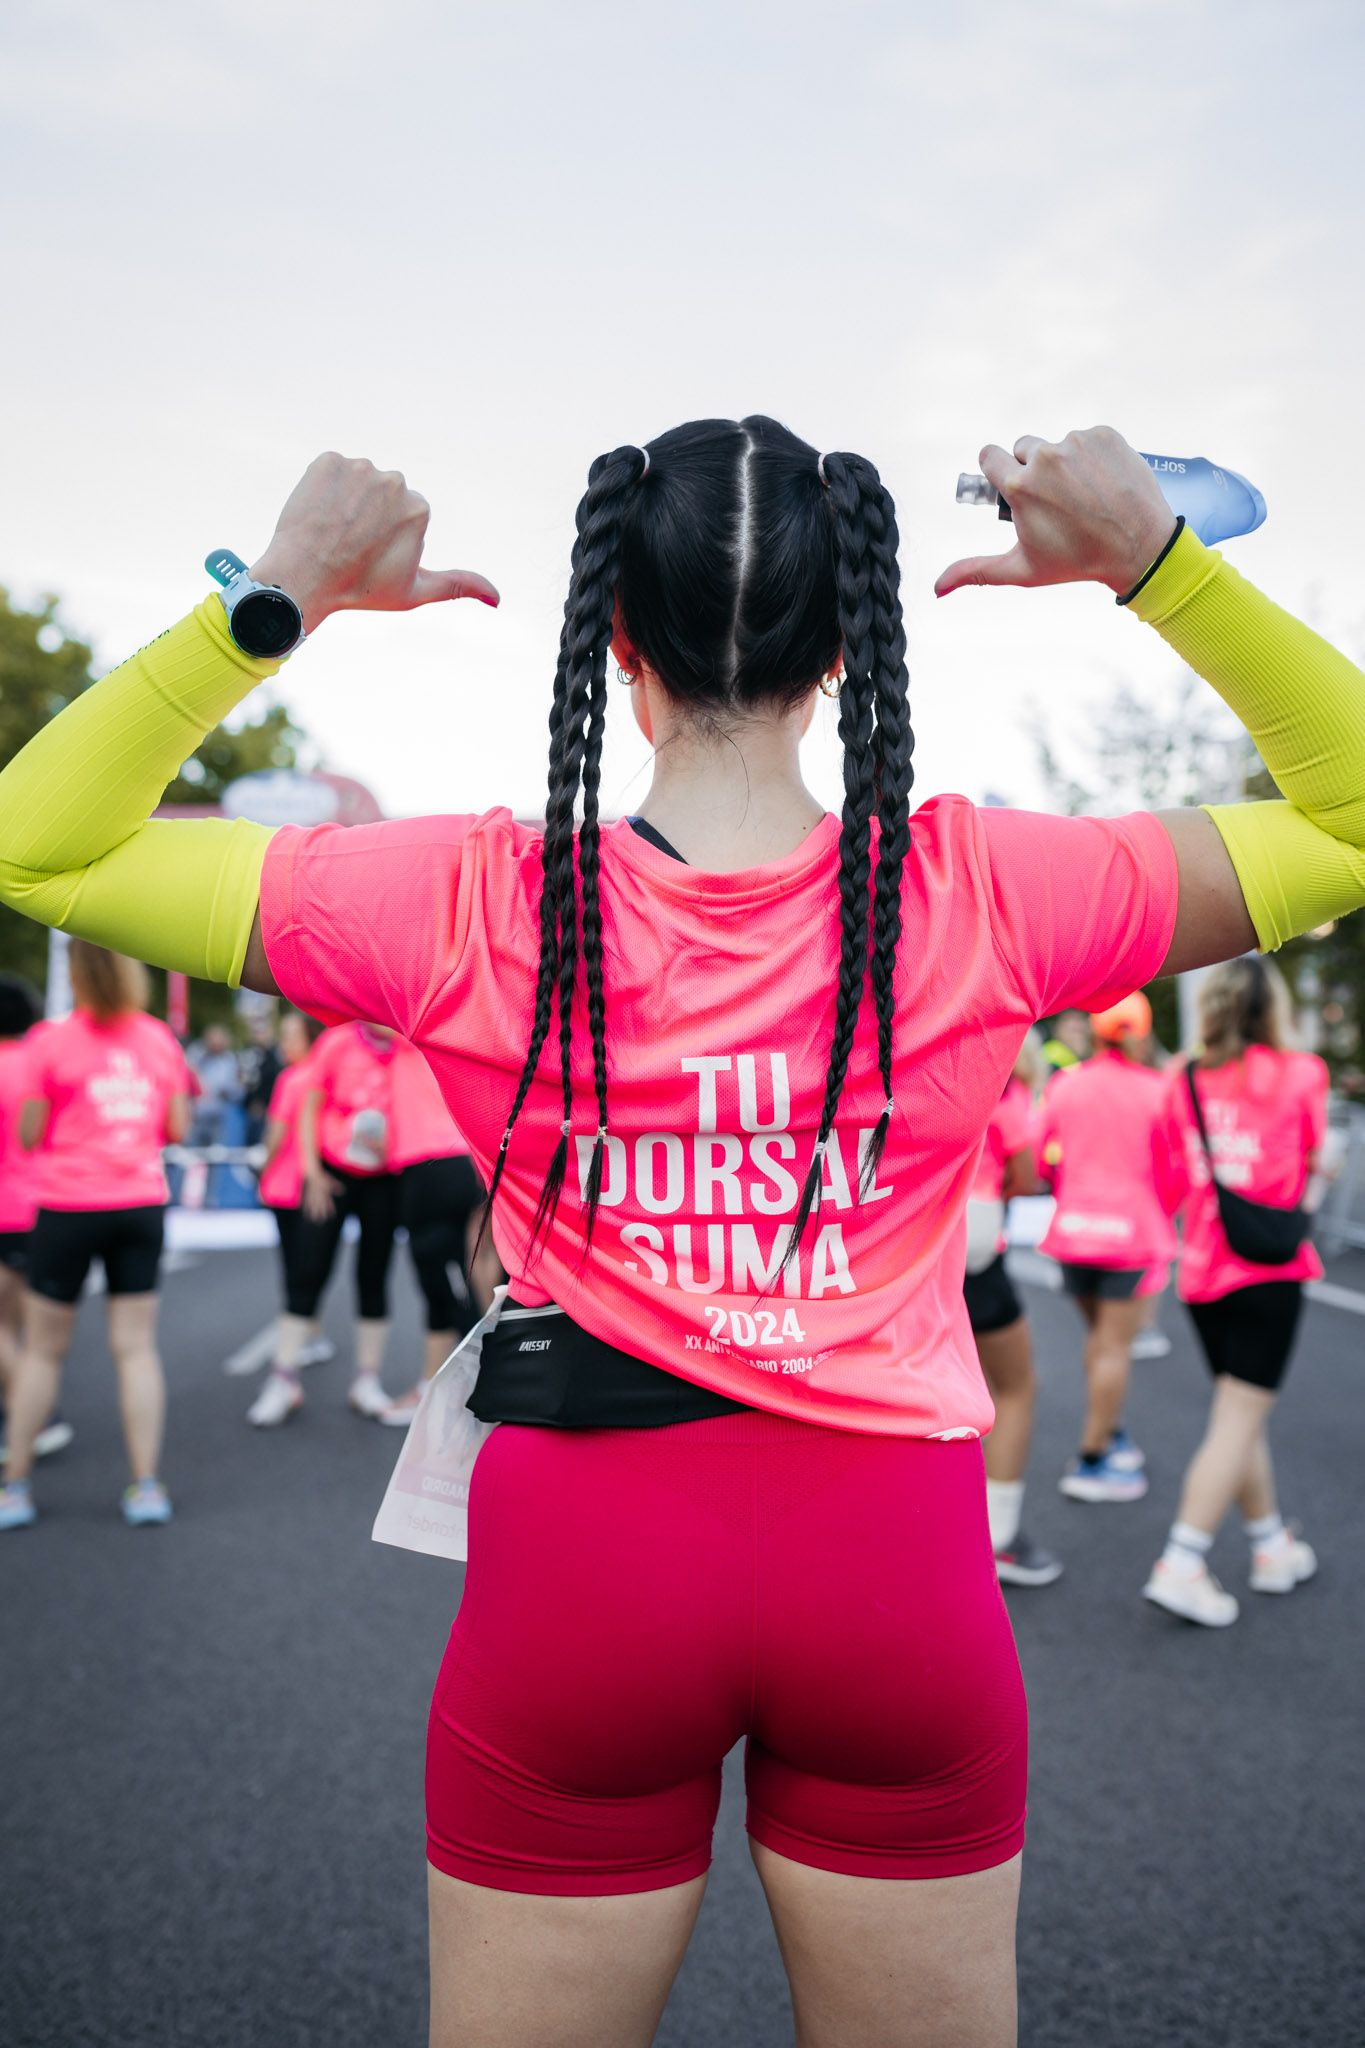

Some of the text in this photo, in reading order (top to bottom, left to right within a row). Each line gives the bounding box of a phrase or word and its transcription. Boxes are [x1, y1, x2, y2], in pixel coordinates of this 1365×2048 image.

[1152, 459, 1186, 474] SOFT
[681, 1052, 791, 1134] TU
[574, 1127, 894, 1216] DORSAL
[619, 1222, 857, 1300] SUMA
[684, 1333, 838, 1375] XX ANIVARIO 2004-
[704, 1305, 807, 1347] 2024
